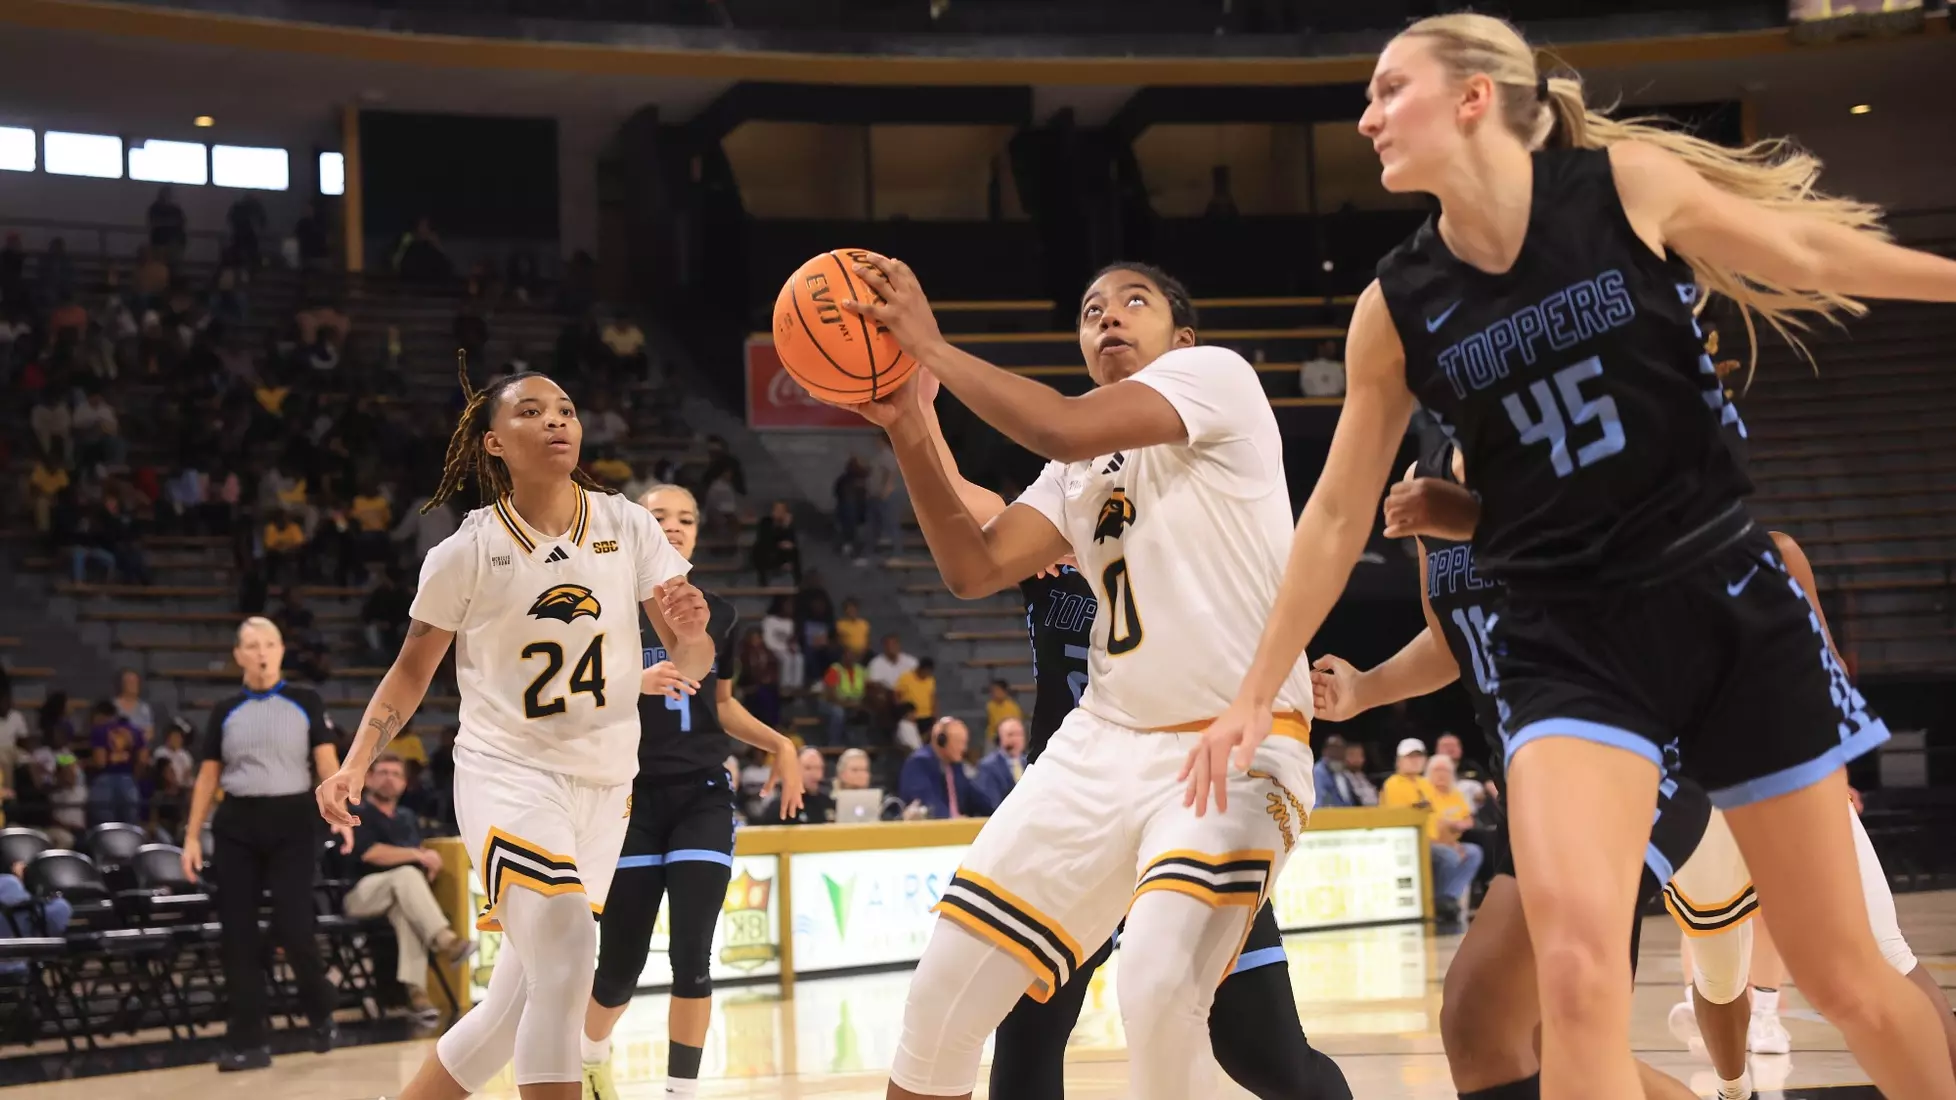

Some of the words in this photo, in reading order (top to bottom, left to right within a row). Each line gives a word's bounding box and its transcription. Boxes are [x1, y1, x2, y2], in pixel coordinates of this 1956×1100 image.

[1438, 269, 1635, 400] TOPPERS
[1501, 355, 1626, 478] 45
[593, 540, 618, 554] SBC
[1102, 556, 1144, 656] 0
[520, 632, 607, 720] 24
